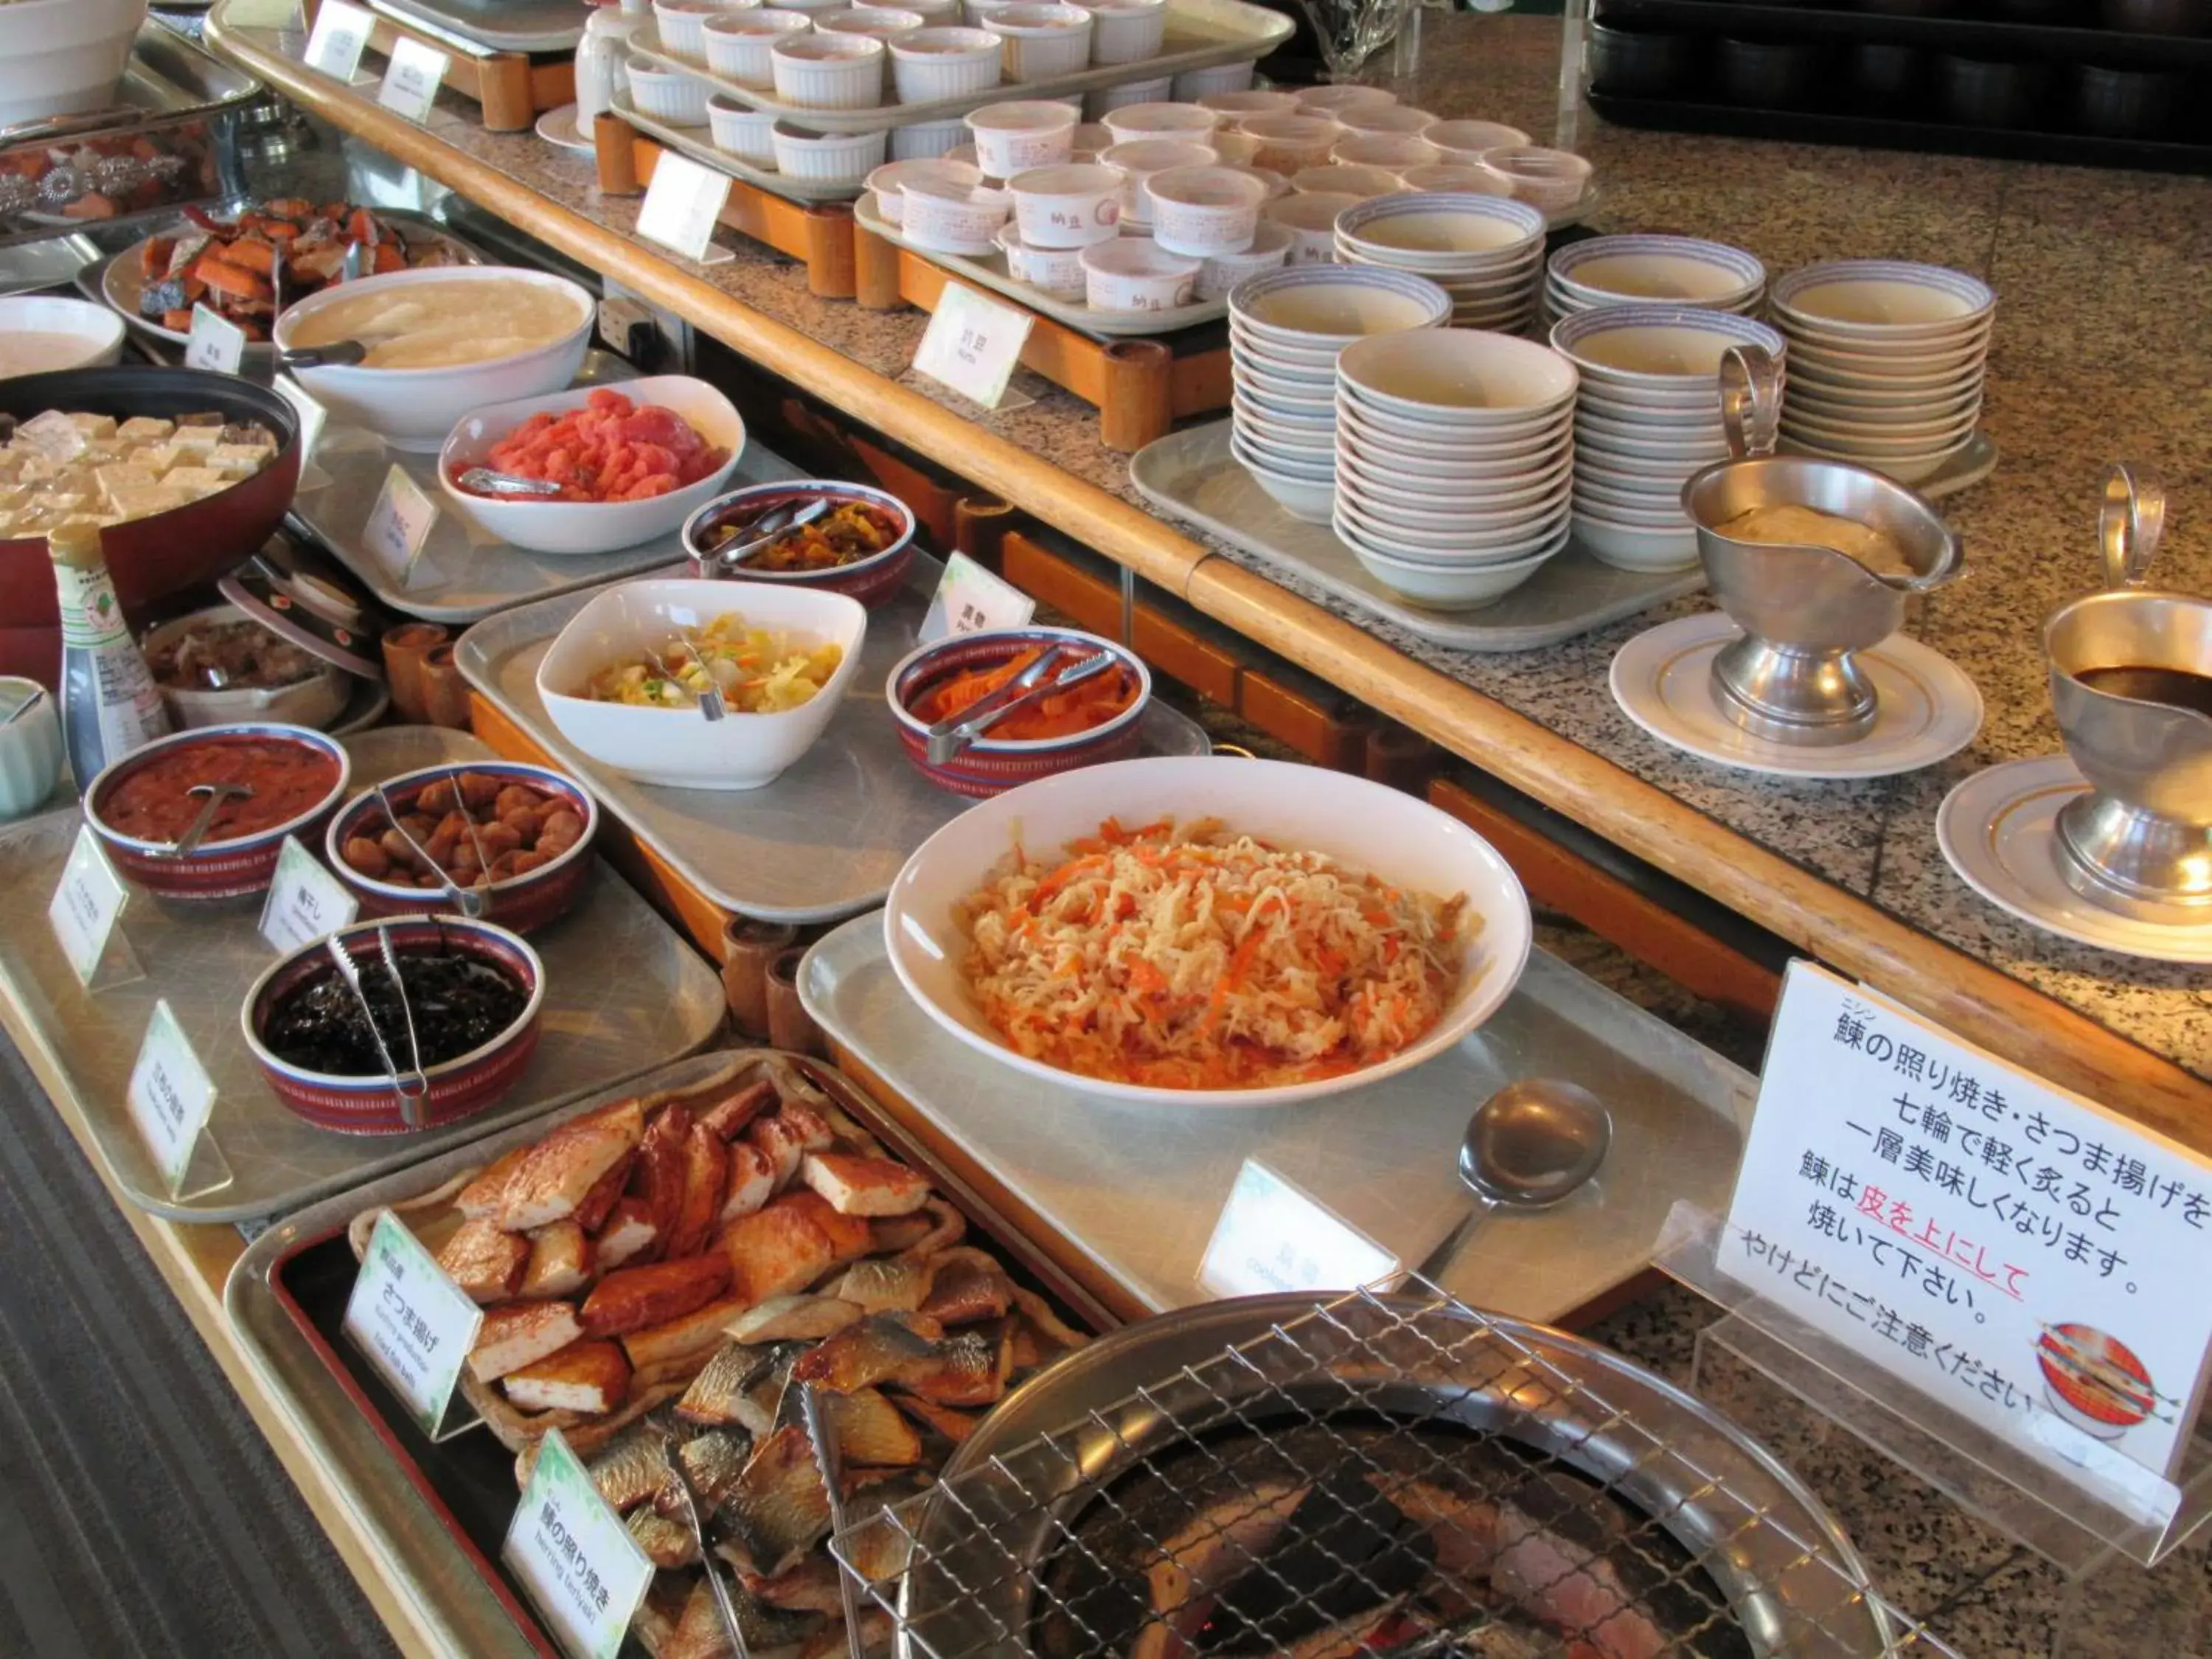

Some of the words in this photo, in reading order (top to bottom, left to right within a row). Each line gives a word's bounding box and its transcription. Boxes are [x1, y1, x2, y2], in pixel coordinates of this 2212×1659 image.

[1846, 1120, 2138, 1294] 一層美味しくなります。
[1892, 1091, 2121, 1232] 七輪で軽く炙ると
[383, 1281, 441, 1353] さつま揚げ
[1806, 1199, 1986, 1324] 焼いて下さい。
